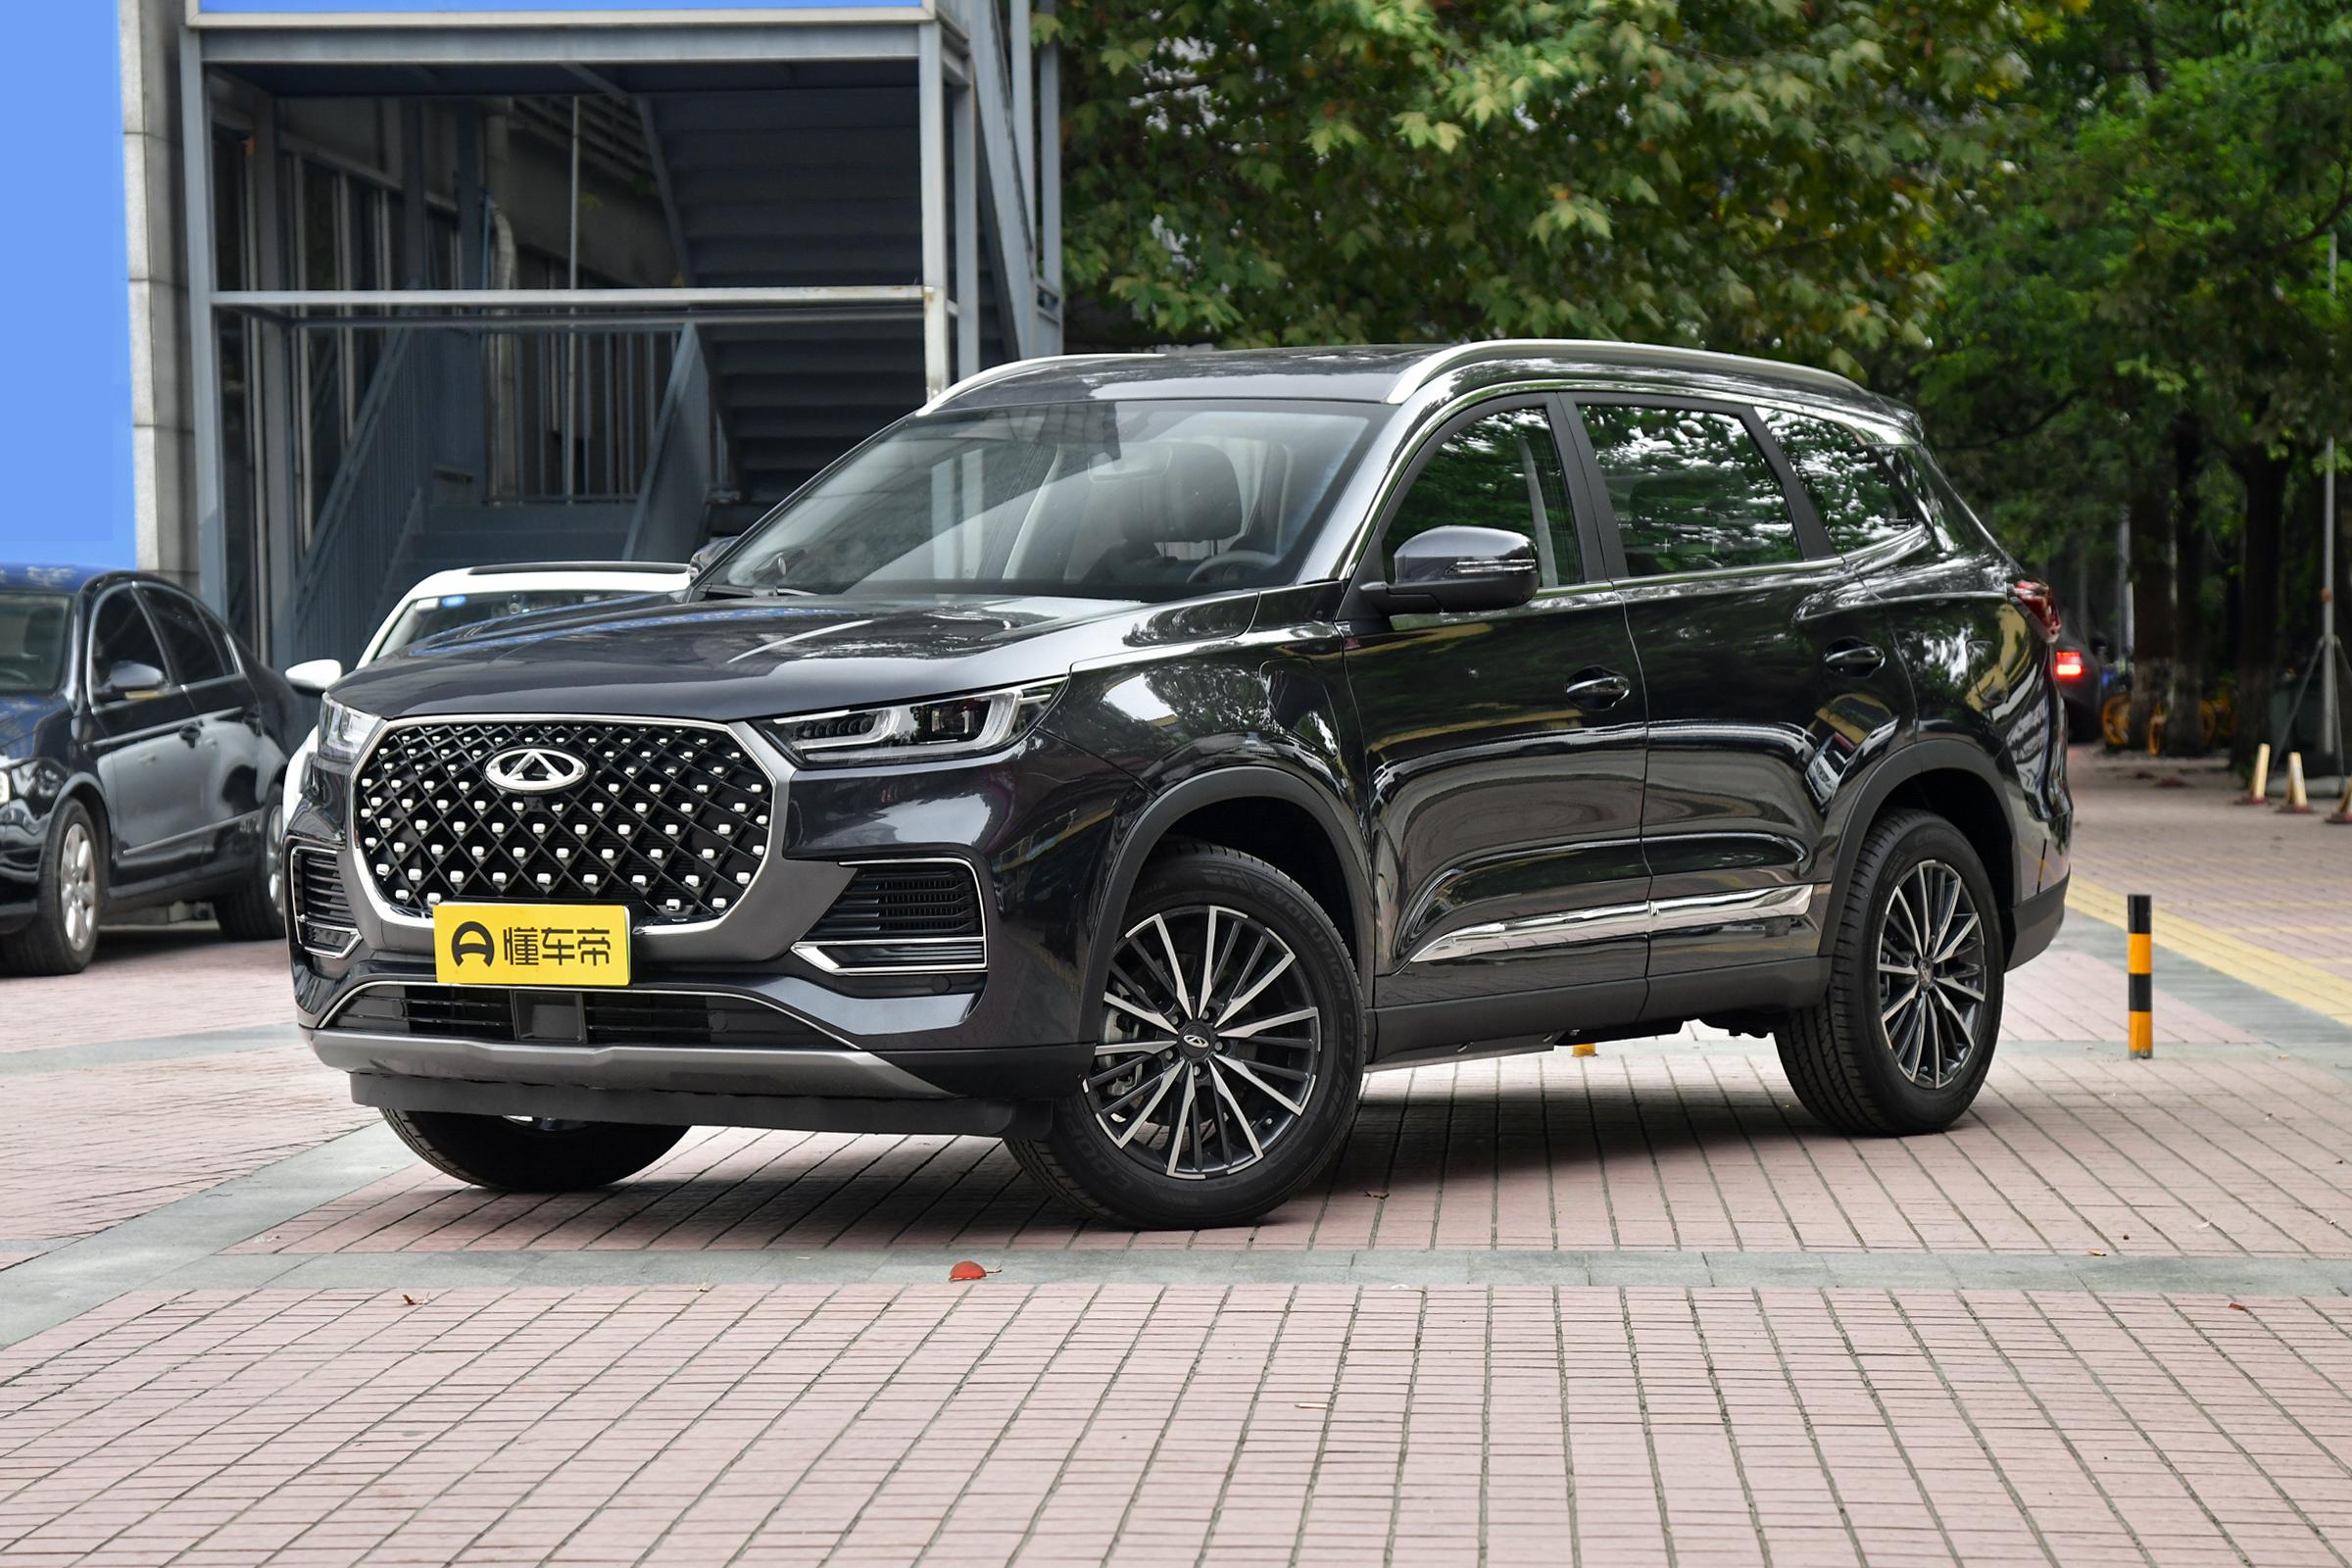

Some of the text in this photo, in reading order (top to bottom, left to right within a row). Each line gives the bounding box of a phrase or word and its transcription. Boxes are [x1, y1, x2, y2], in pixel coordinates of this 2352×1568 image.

[503, 927, 612, 966] 懂车帝
[1255, 883, 1348, 1001] EVOLUTION
